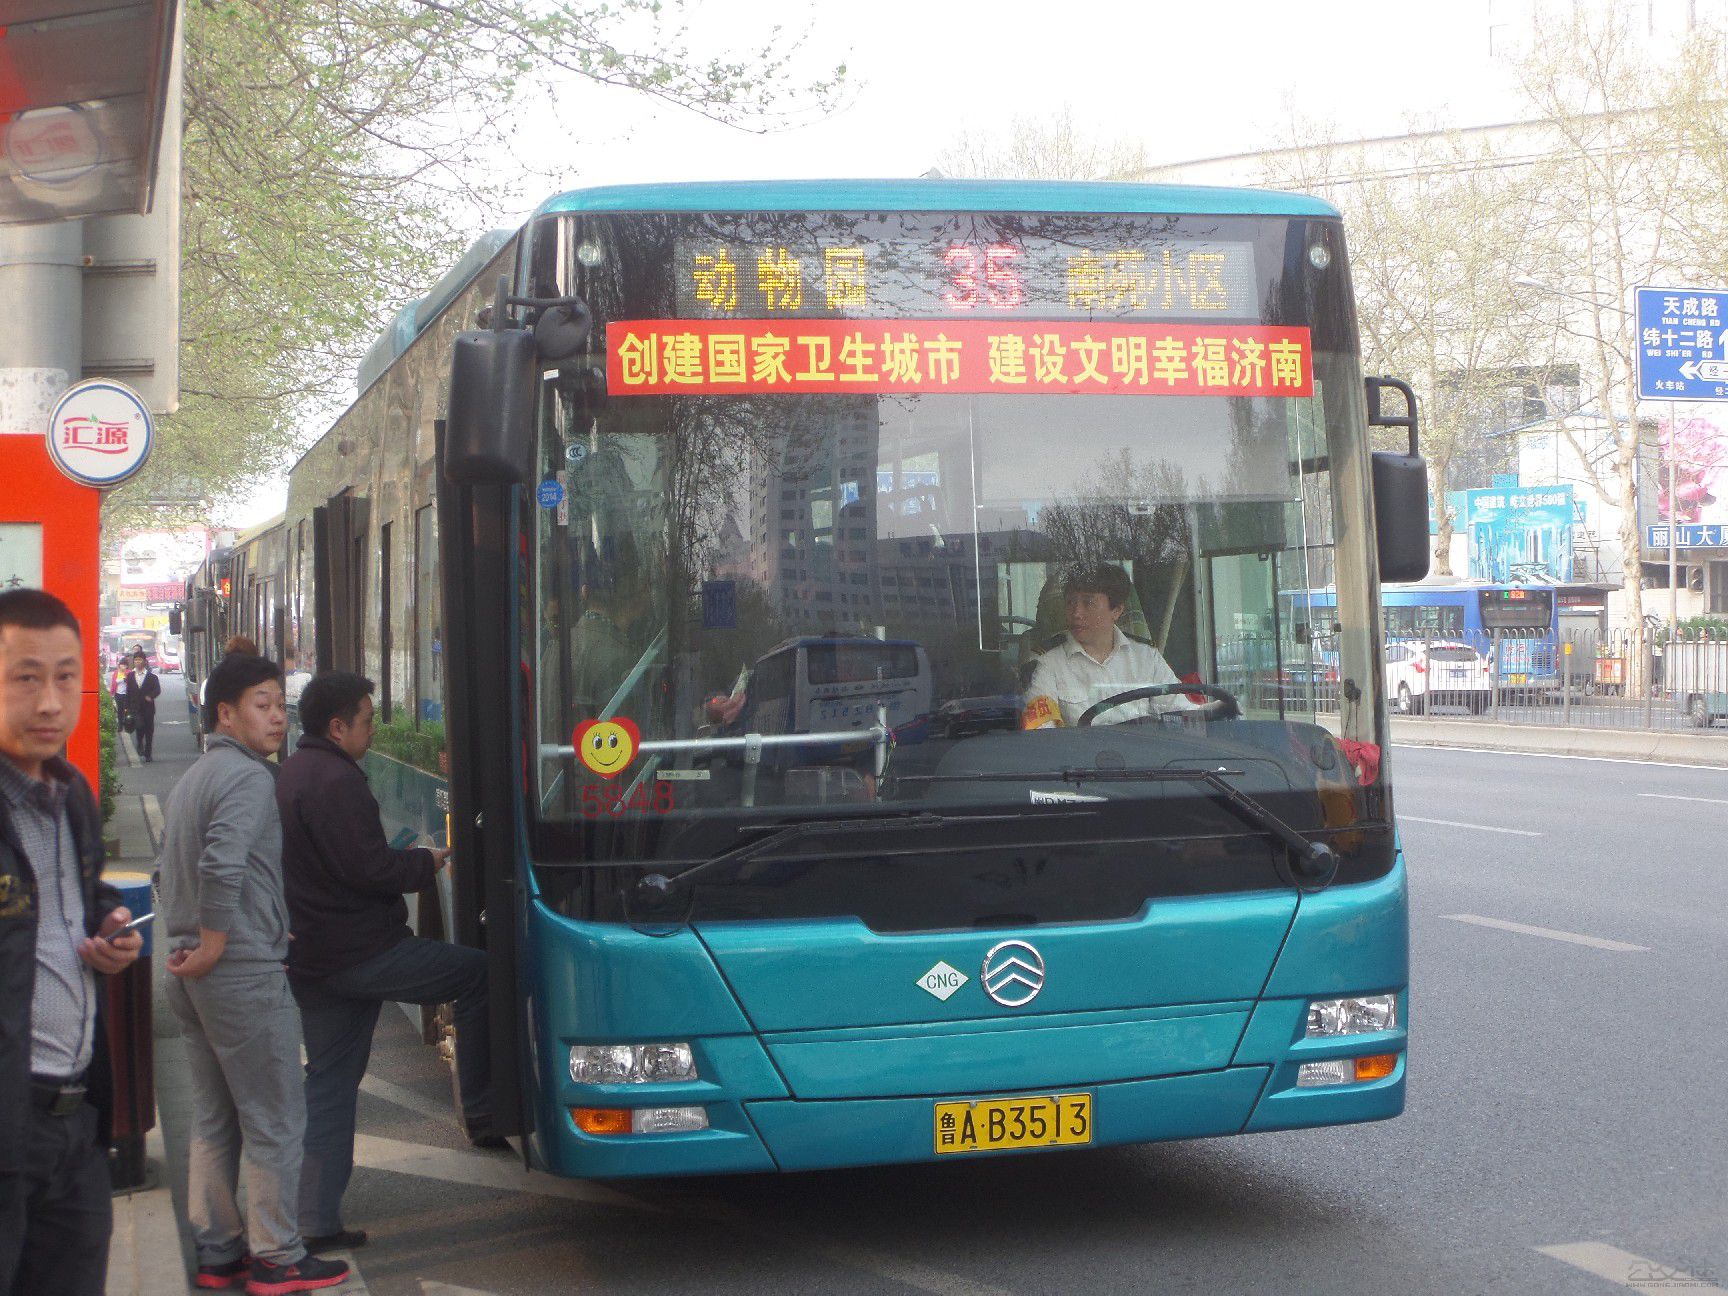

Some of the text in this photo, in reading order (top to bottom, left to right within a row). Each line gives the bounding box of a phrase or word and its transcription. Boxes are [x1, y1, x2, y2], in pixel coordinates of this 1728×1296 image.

[692, 247, 867, 310] 动物园
[944, 245, 1021, 309] 35
[1663, 296, 1718, 317] 天成路
[1661, 317, 1720, 327] TIAN CHENG RD
[1643, 327, 1713, 349] 纬十二路
[617, 331, 1303, 389] 创建国家卫生城市 建设文明幸福济南
[1646, 348, 1661, 357] WEI
[1701, 350, 1713, 359] RD
[1655, 379, 1685, 391] 火车站
[63, 425, 129, 446] 汇源
[580, 782, 674, 817] 5848
[926, 972, 959, 989] CNG
